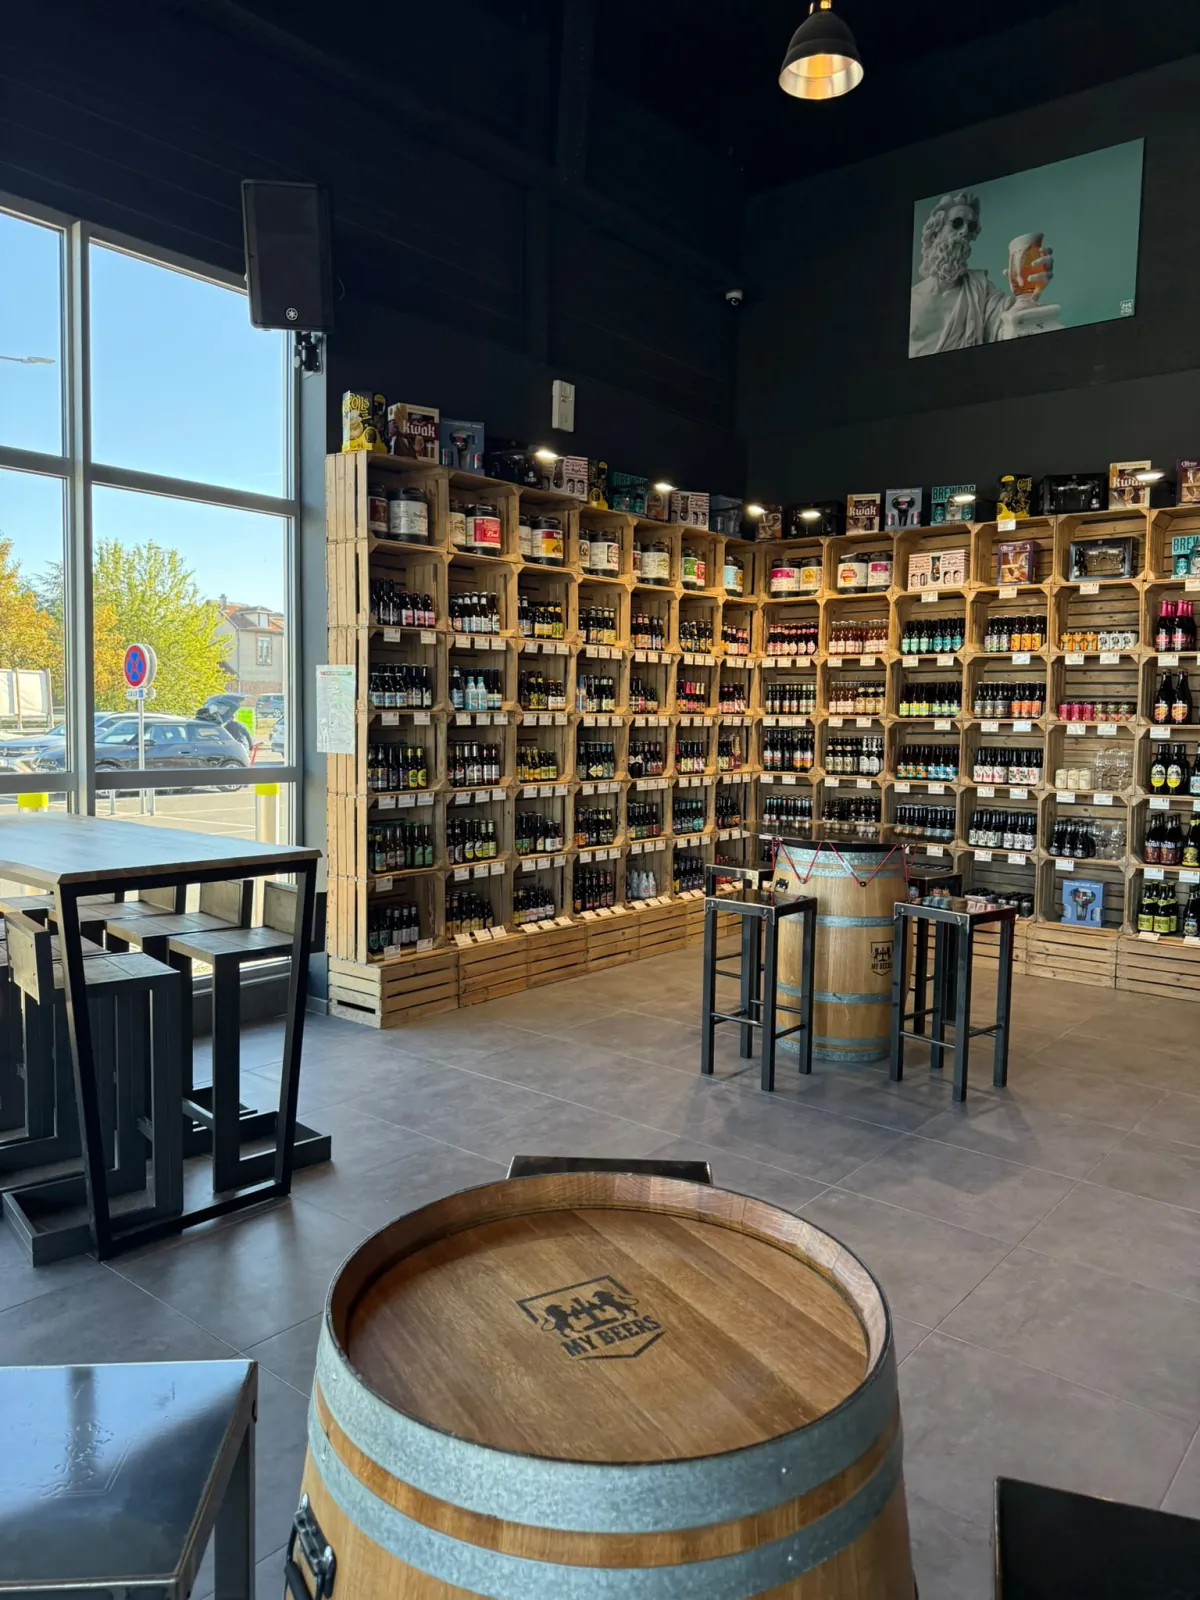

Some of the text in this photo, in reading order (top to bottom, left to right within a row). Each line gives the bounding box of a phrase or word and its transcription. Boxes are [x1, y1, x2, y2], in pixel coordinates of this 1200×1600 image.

[403, 419, 436, 438] kwak
[1112, 476, 1146, 488] kwa
[850, 505, 876, 517] kwak
[560, 1314, 662, 1357] MY BEERS
